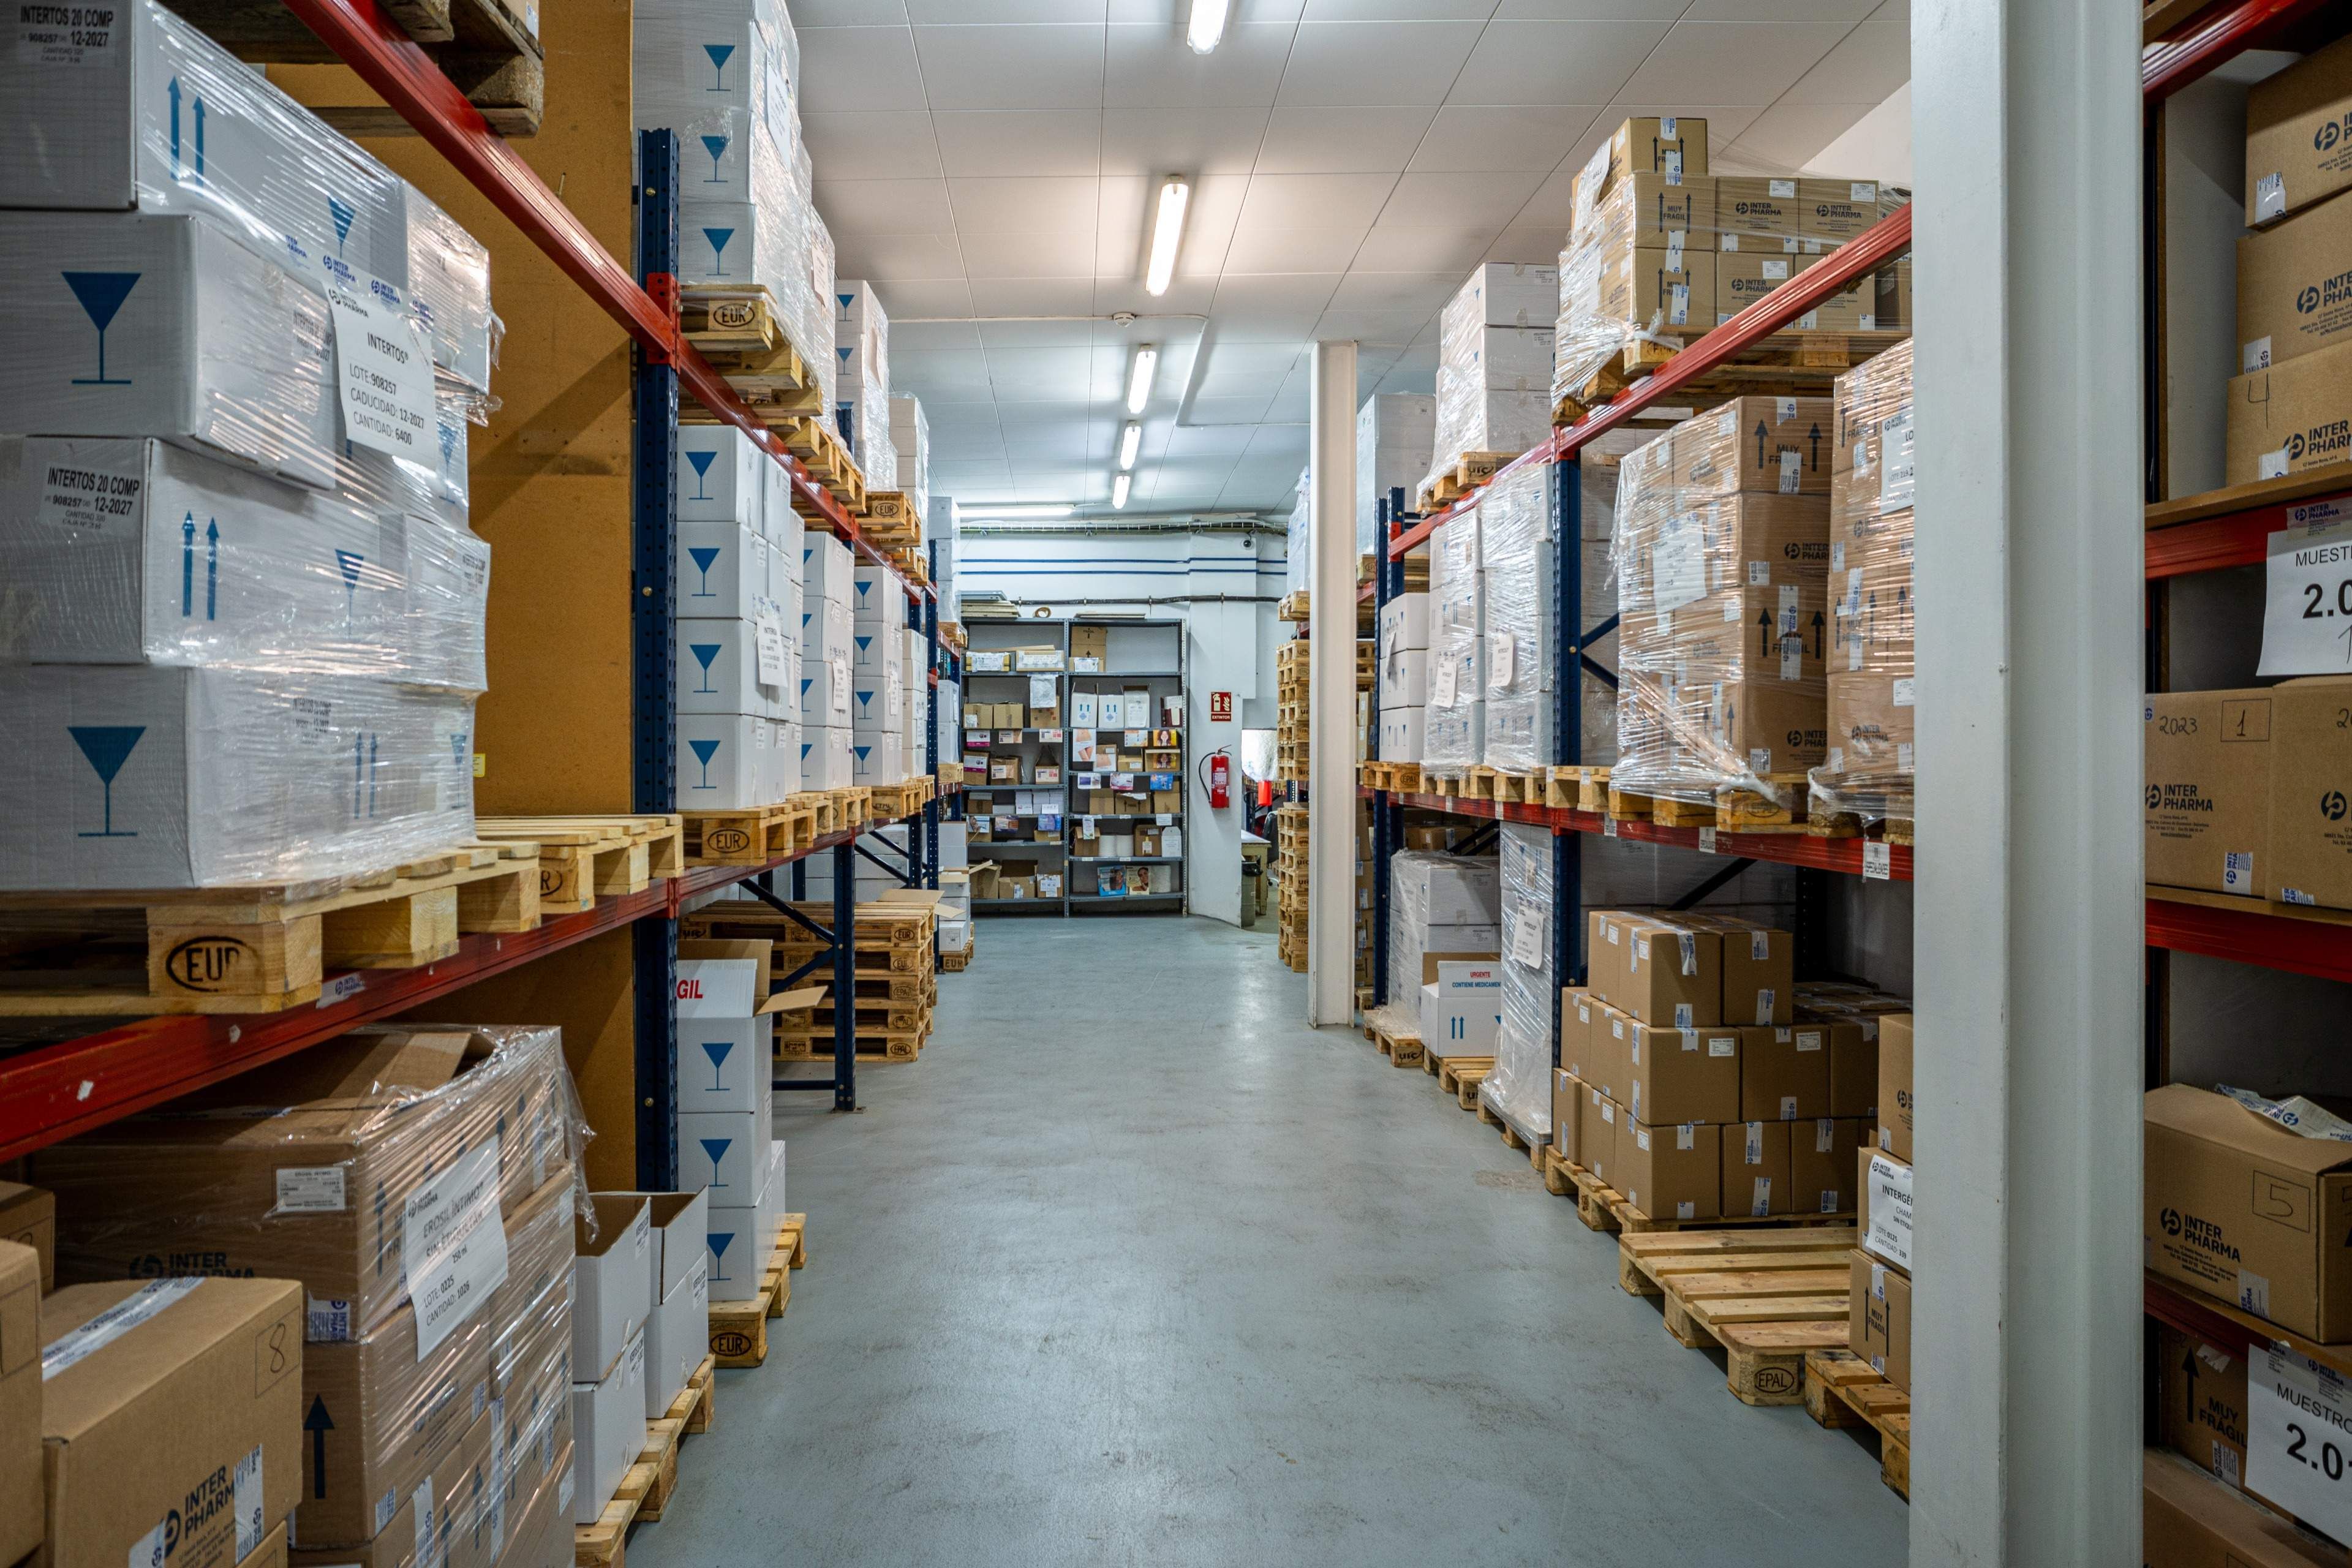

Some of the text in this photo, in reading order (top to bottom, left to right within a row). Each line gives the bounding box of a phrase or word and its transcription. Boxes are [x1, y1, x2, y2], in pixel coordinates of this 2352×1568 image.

[21, 6, 113, 28] INTERTOS 20 COMP
[70, 31, 108, 47] 12-2027
[333, 258, 349, 272] INTER
[333, 266, 356, 282] PHARMA
[380, 290, 400, 304] PHARMA
[342, 299, 369, 318] PHARMA
[722, 307, 746, 323] EUR
[350, 387, 424, 430] CADUCIDAD: 12-2027
[2248, 373, 2269, 429] 4
[353, 411, 412, 446] CANTIDAD: 6400
[2309, 419, 2348, 442] INTER
[48, 467, 140, 497] INTERTOS 20 COMP
[53, 495, 133, 516] 908257 12-2027
[880, 505, 894, 515] EUR
[2308, 509, 2340, 519] PHARMA
[65, 510, 94, 521] CANTIDAD
[1803, 551, 1829, 560] PHAR
[2295, 546, 2352, 568] MUEST
[1862, 725, 1880, 733] INTER
[2159, 709, 2246, 736] 2023 1
[2165, 784, 2197, 797] INTER
[2164, 797, 2213, 812] PHARMA
[716, 833, 741, 850] EUR
[898, 930, 911, 940] EUR
[1878, 1169, 1894, 1181] PHARMA
[1879, 1164, 1891, 1172] INTER
[2267, 1183, 2294, 1218] 5
[423, 1210, 450, 1238] EROSIL
[2184, 1214, 2222, 1240] INTER
[453, 1244, 468, 1264] 250 ml
[1875, 1236, 1899, 1256] CANTIDAD:
[2184, 1231, 2241, 1263] PHARMA
[170, 1253, 227, 1268] INTER
[170, 1267, 255, 1278] PHARMA
[424, 1275, 454, 1309] LOTE: 0225
[426, 1280, 470, 1327] CANTIDAD: 1026
[1871, 1308, 1882, 1322] MUY
[1868, 1316, 1886, 1336] FRAGIL
[270, 1322, 286, 1374] 8
[718, 1336, 742, 1353] EUR
[2319, 1362, 2336, 1376] INTER
[2319, 1369, 2344, 1387] PHARMA
[1758, 1372, 1788, 1389] EPAL
[2209, 1396, 2238, 1424] MUY
[2199, 1408, 2247, 1448] FRÁGIL
[2286, 1422, 2352, 1482] 2.0
[185, 1464, 227, 1517] INTER
[185, 1478, 235, 1540] PHARM
